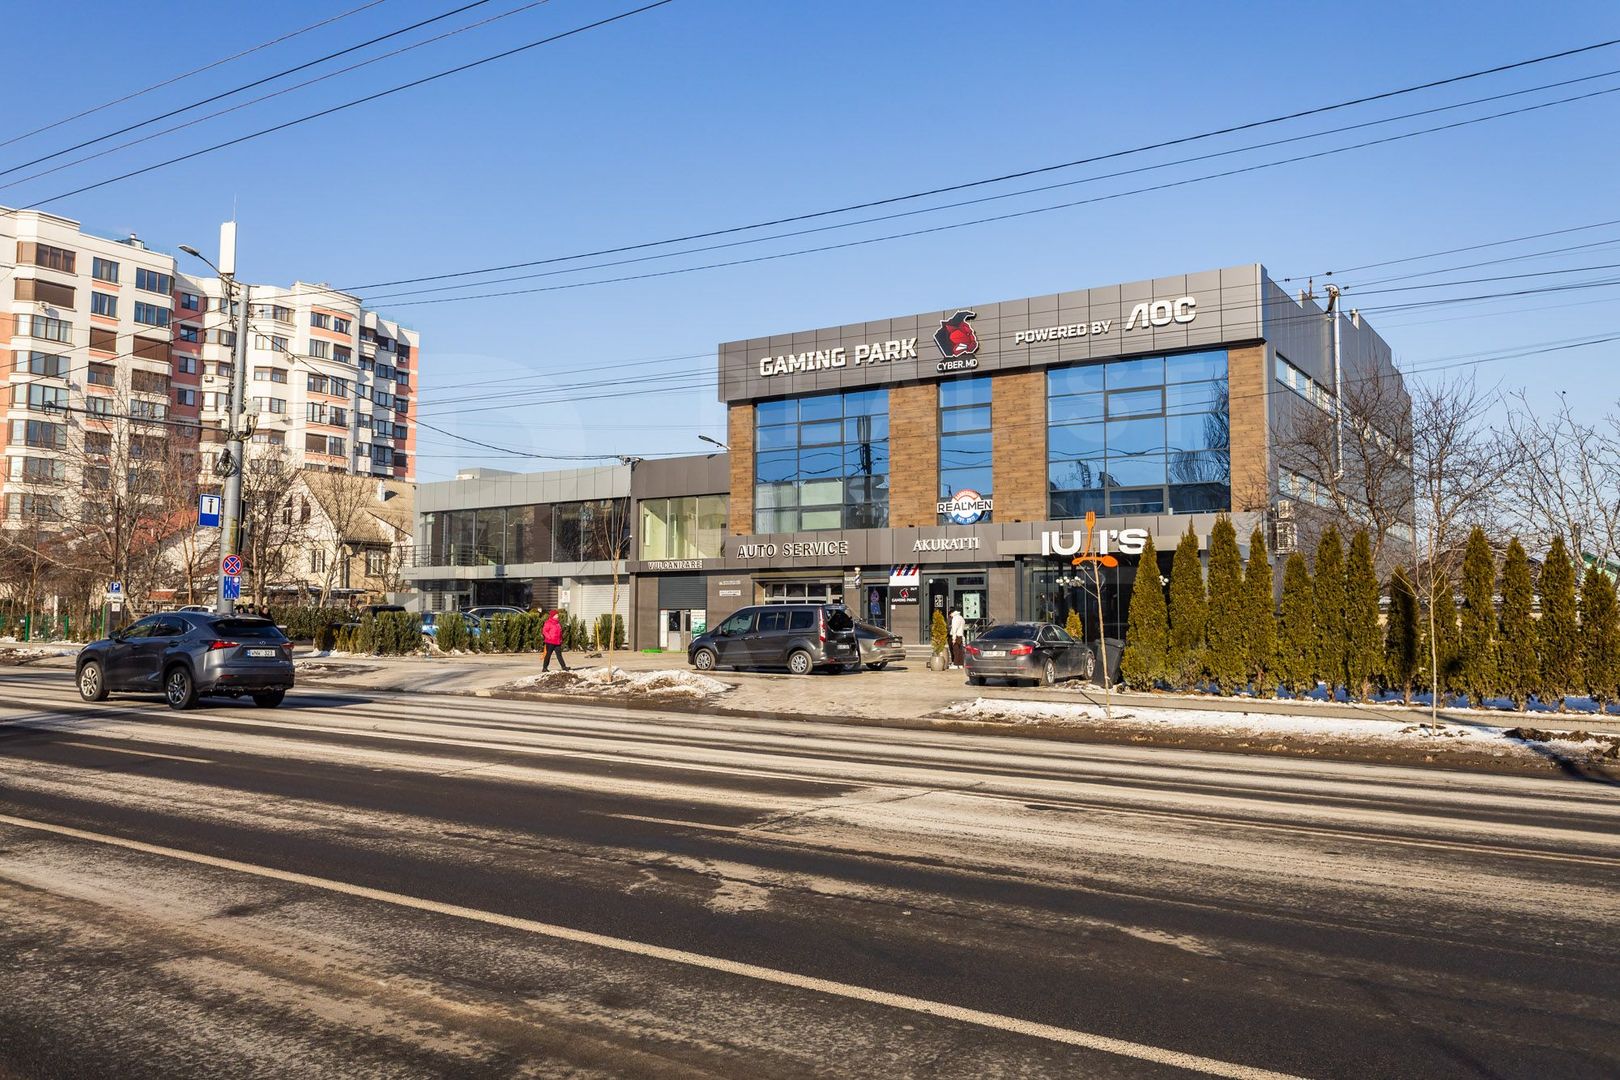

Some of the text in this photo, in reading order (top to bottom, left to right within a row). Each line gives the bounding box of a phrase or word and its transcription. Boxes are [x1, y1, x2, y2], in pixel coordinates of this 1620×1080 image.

[1015, 323, 1086, 345] POWERED
[1088, 319, 1113, 337] BY
[759, 337, 918, 377] GAMING PARK
[936, 359, 978, 371] CYBER.MD
[737, 540, 849, 559] AUTO SERVICE
[912, 537, 981, 552] AKURATTI
[648, 560, 703, 570] VULCANIZARE
